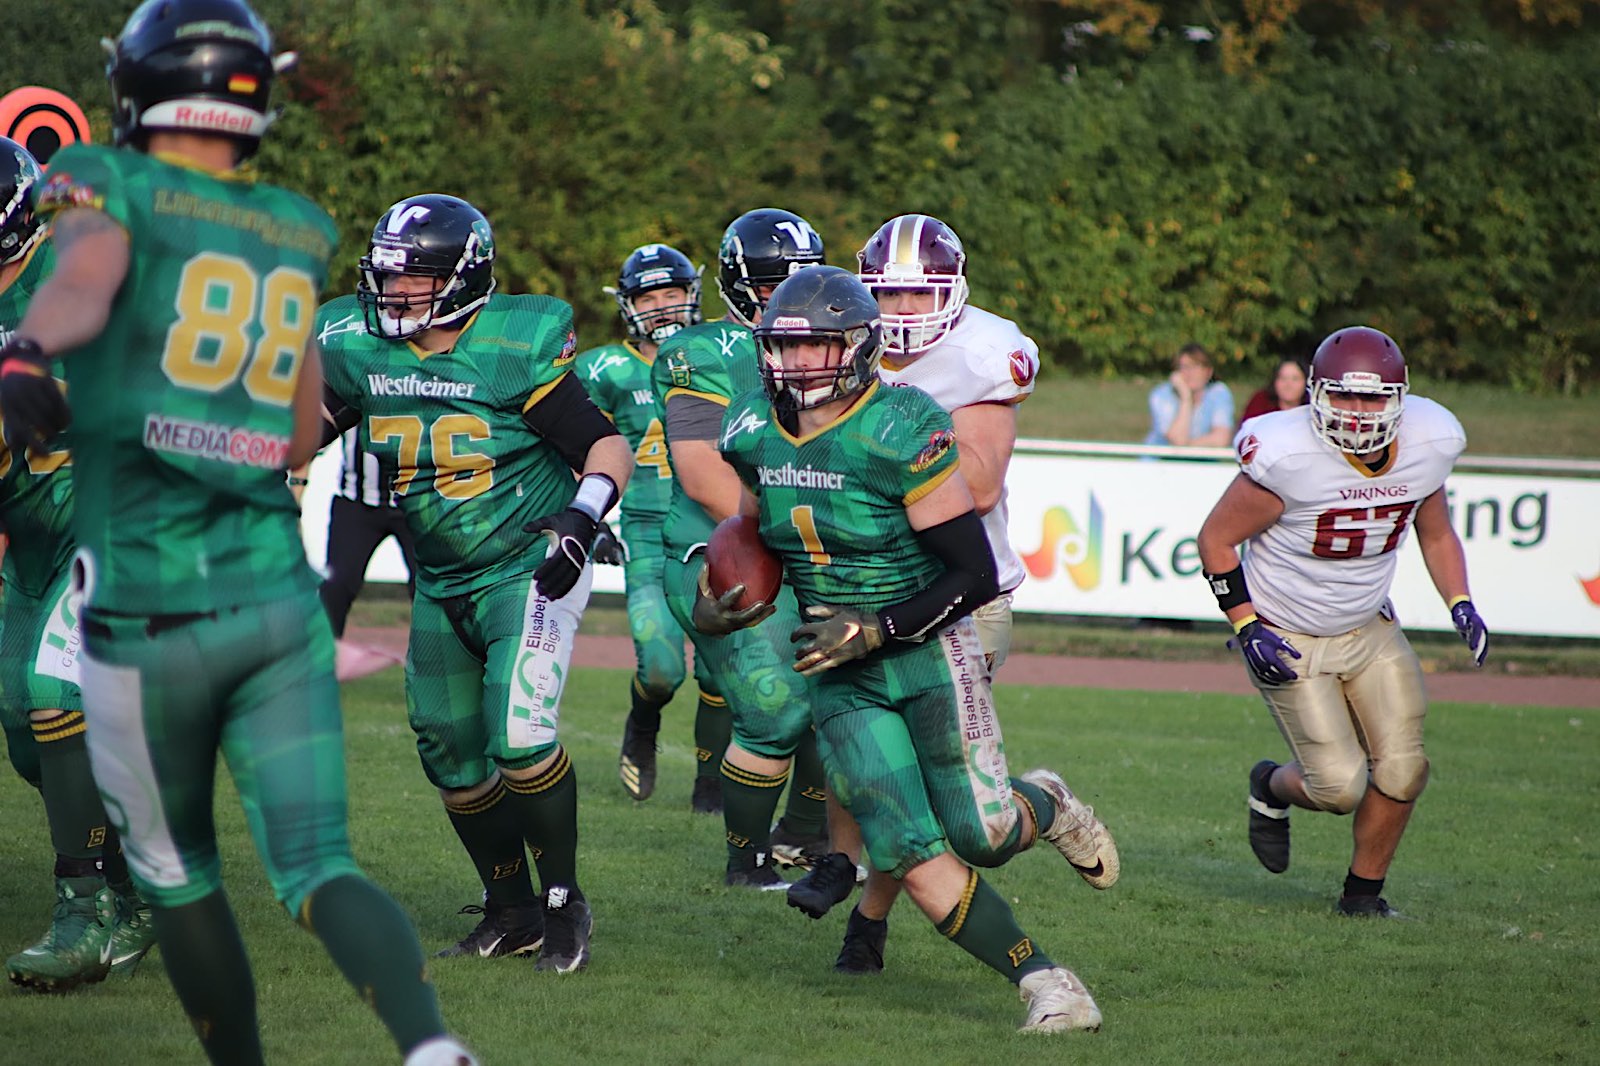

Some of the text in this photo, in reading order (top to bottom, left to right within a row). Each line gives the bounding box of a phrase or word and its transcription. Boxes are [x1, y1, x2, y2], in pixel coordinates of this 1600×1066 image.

[176, 106, 253, 130] Riddell
[161, 251, 316, 408] 88
[776, 319, 804, 327] Riddell
[367, 374, 476, 399] Westheimer
[146, 419, 290, 467] MEDIACOM
[368, 414, 496, 500] 76
[635, 418, 673, 479] 4
[758, 461, 846, 490] Westheimer
[1339, 486, 1409, 501] VIKINGS
[791, 504, 832, 566] 1
[1311, 501, 1418, 559] 67
[526, 597, 547, 648] Elisabet
[543, 619, 561, 654] Bigge
[945, 627, 981, 741] Elisabeth-Klinik
[979, 697, 994, 738] Bigge
[1008, 938, 1033, 967] B
